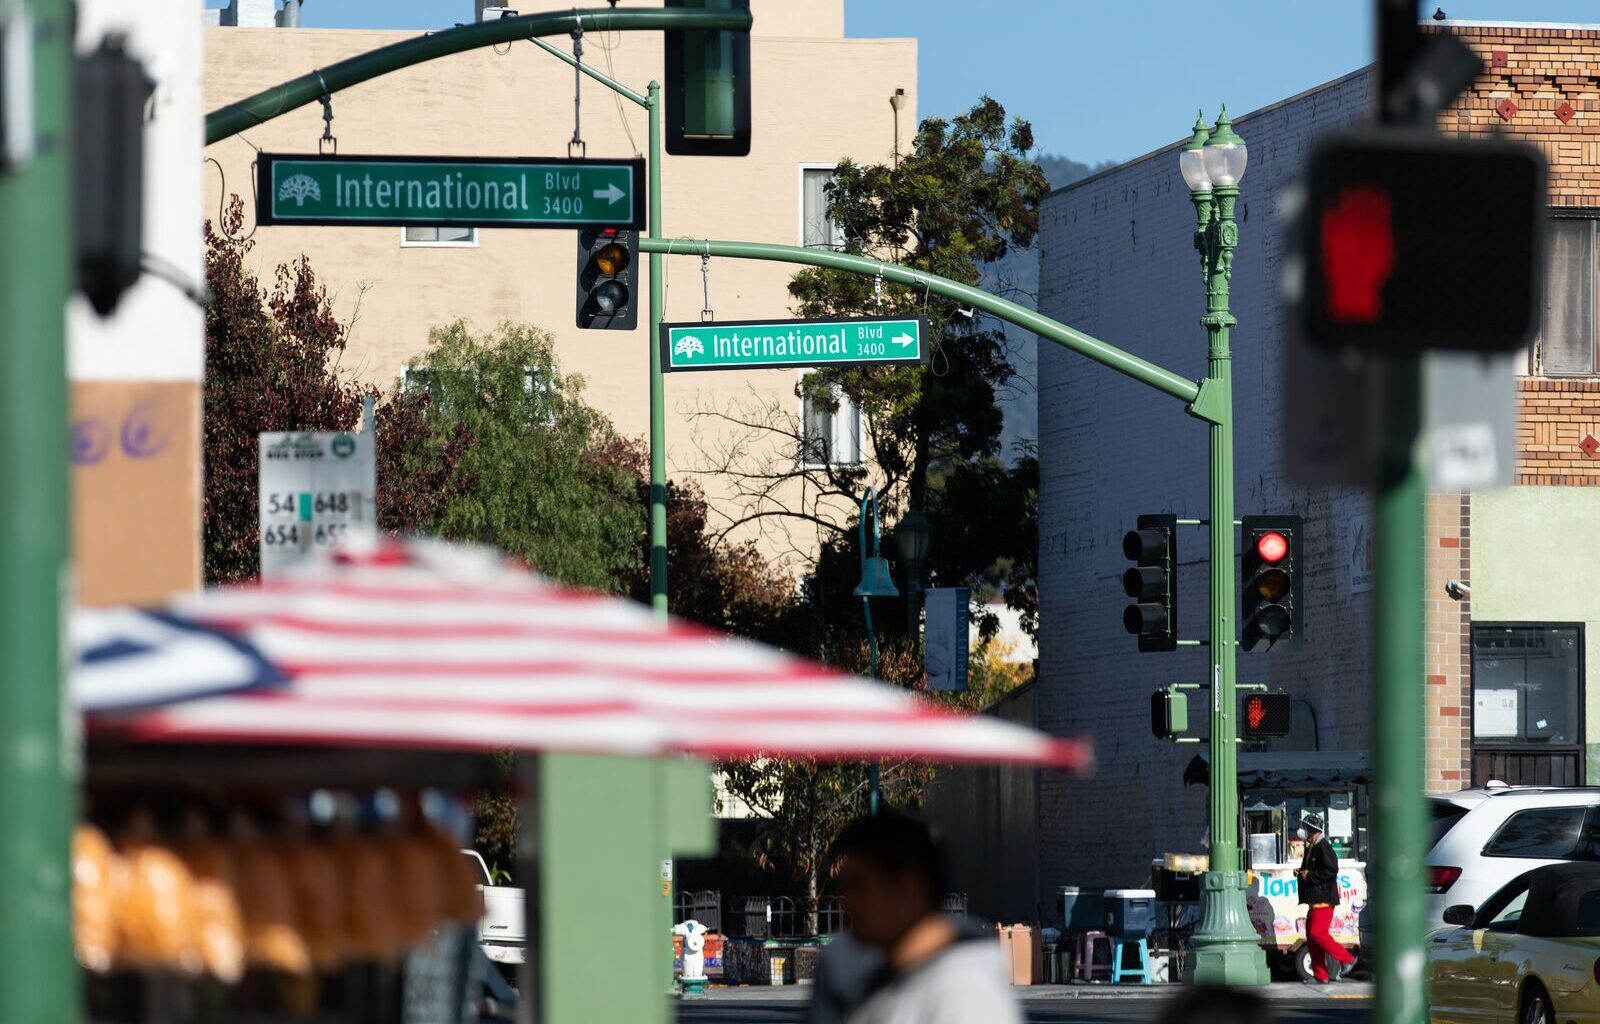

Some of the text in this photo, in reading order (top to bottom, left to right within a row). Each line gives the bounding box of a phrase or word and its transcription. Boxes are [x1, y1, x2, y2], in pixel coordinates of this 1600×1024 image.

[545, 172, 580, 190] Blvd
[335, 173, 529, 210] International
[542, 196, 583, 214] 3400
[858, 326, 883, 340] Blvd
[713, 328, 848, 358] International
[857, 342, 886, 356] 3400
[269, 492, 348, 514] 54 648
[265, 525, 298, 545] 654
